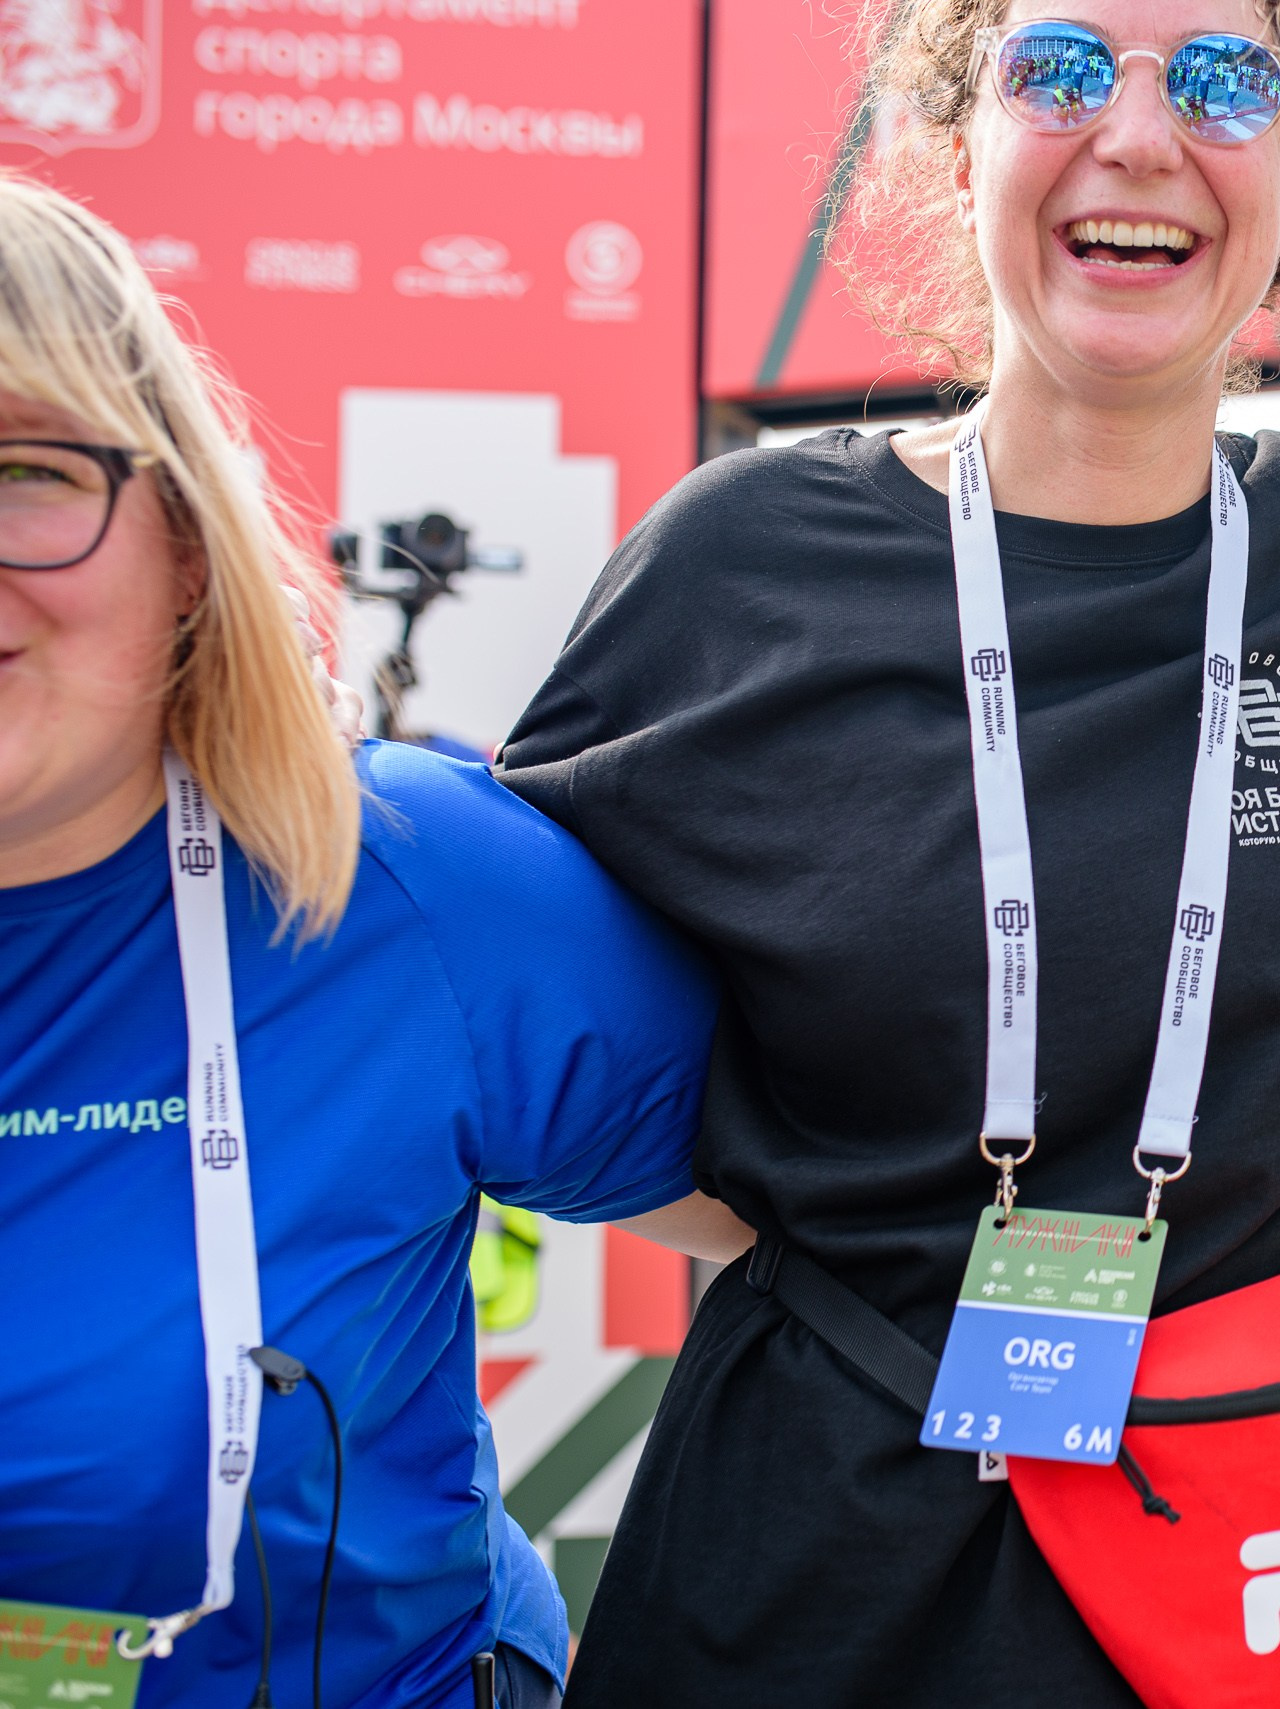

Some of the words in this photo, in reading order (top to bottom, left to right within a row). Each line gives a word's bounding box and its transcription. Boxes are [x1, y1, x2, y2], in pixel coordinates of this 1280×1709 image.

[194, 26, 402, 90] спорта
[959, 457, 972, 520] СООБЩЕСТВО
[967, 451, 980, 493] БЕГОВОЕ
[981, 687, 996, 752] COMMUNITY
[994, 687, 1006, 735] RUNNING
[1207, 691, 1220, 757] COMMUNITY
[1216, 695, 1229, 745] RUNNING
[1231, 788, 1263, 811] ОЯ
[1238, 836, 1276, 847] КОТОРУЮ
[1003, 943, 1013, 1028] СООБЩЕСТВО
[1016, 943, 1026, 997] БЕГОВОЕ
[1172, 946, 1192, 1027] СООБЩЕСТВО
[1188, 948, 1204, 999] БЕГОВОЕ
[204, 1063, 214, 1121] RUNNING
[215, 1043, 228, 1121] COMMUNITY
[0, 1096, 187, 1138] им-лиде
[1003, 1336, 1076, 1371] ORG
